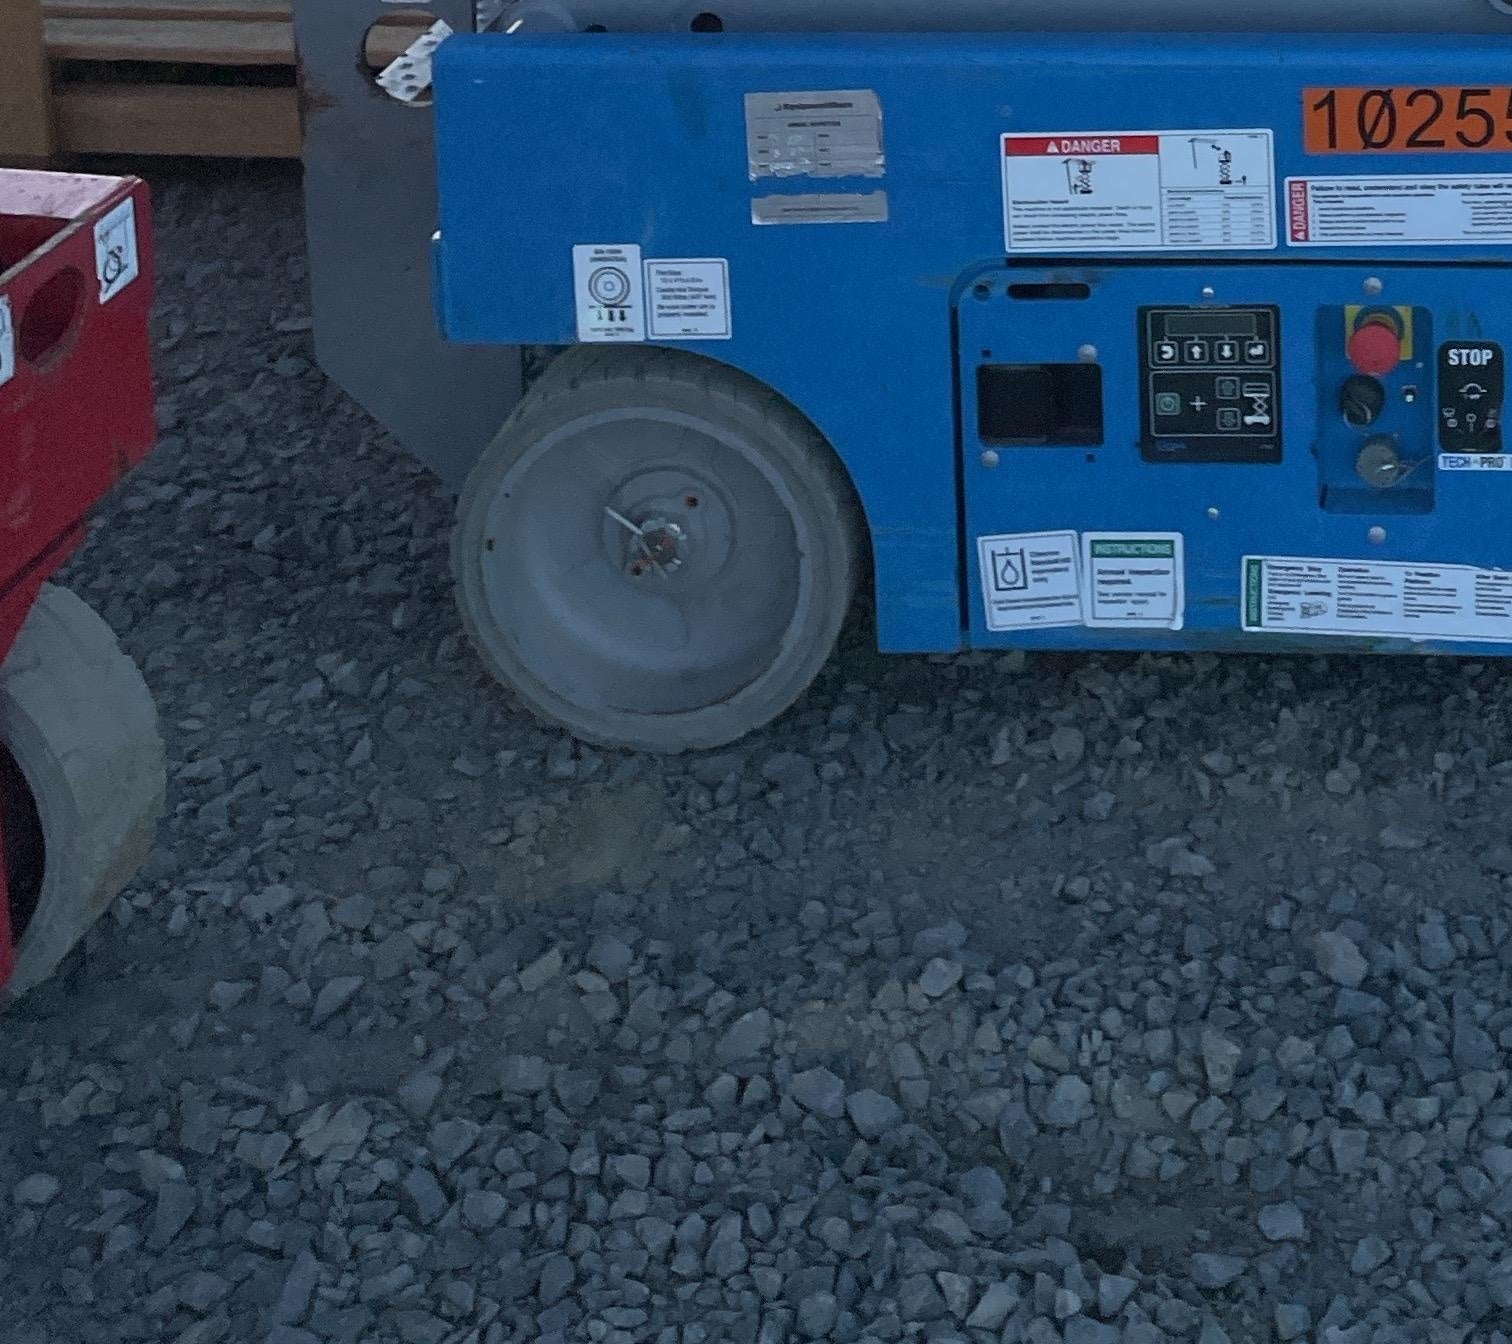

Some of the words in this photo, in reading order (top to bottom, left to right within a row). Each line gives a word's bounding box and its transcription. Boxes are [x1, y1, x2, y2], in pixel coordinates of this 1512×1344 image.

[1061, 139, 1121, 154] DANGER
[1291, 182, 1306, 231] DANGER
[1447, 348, 1493, 366] STOP
